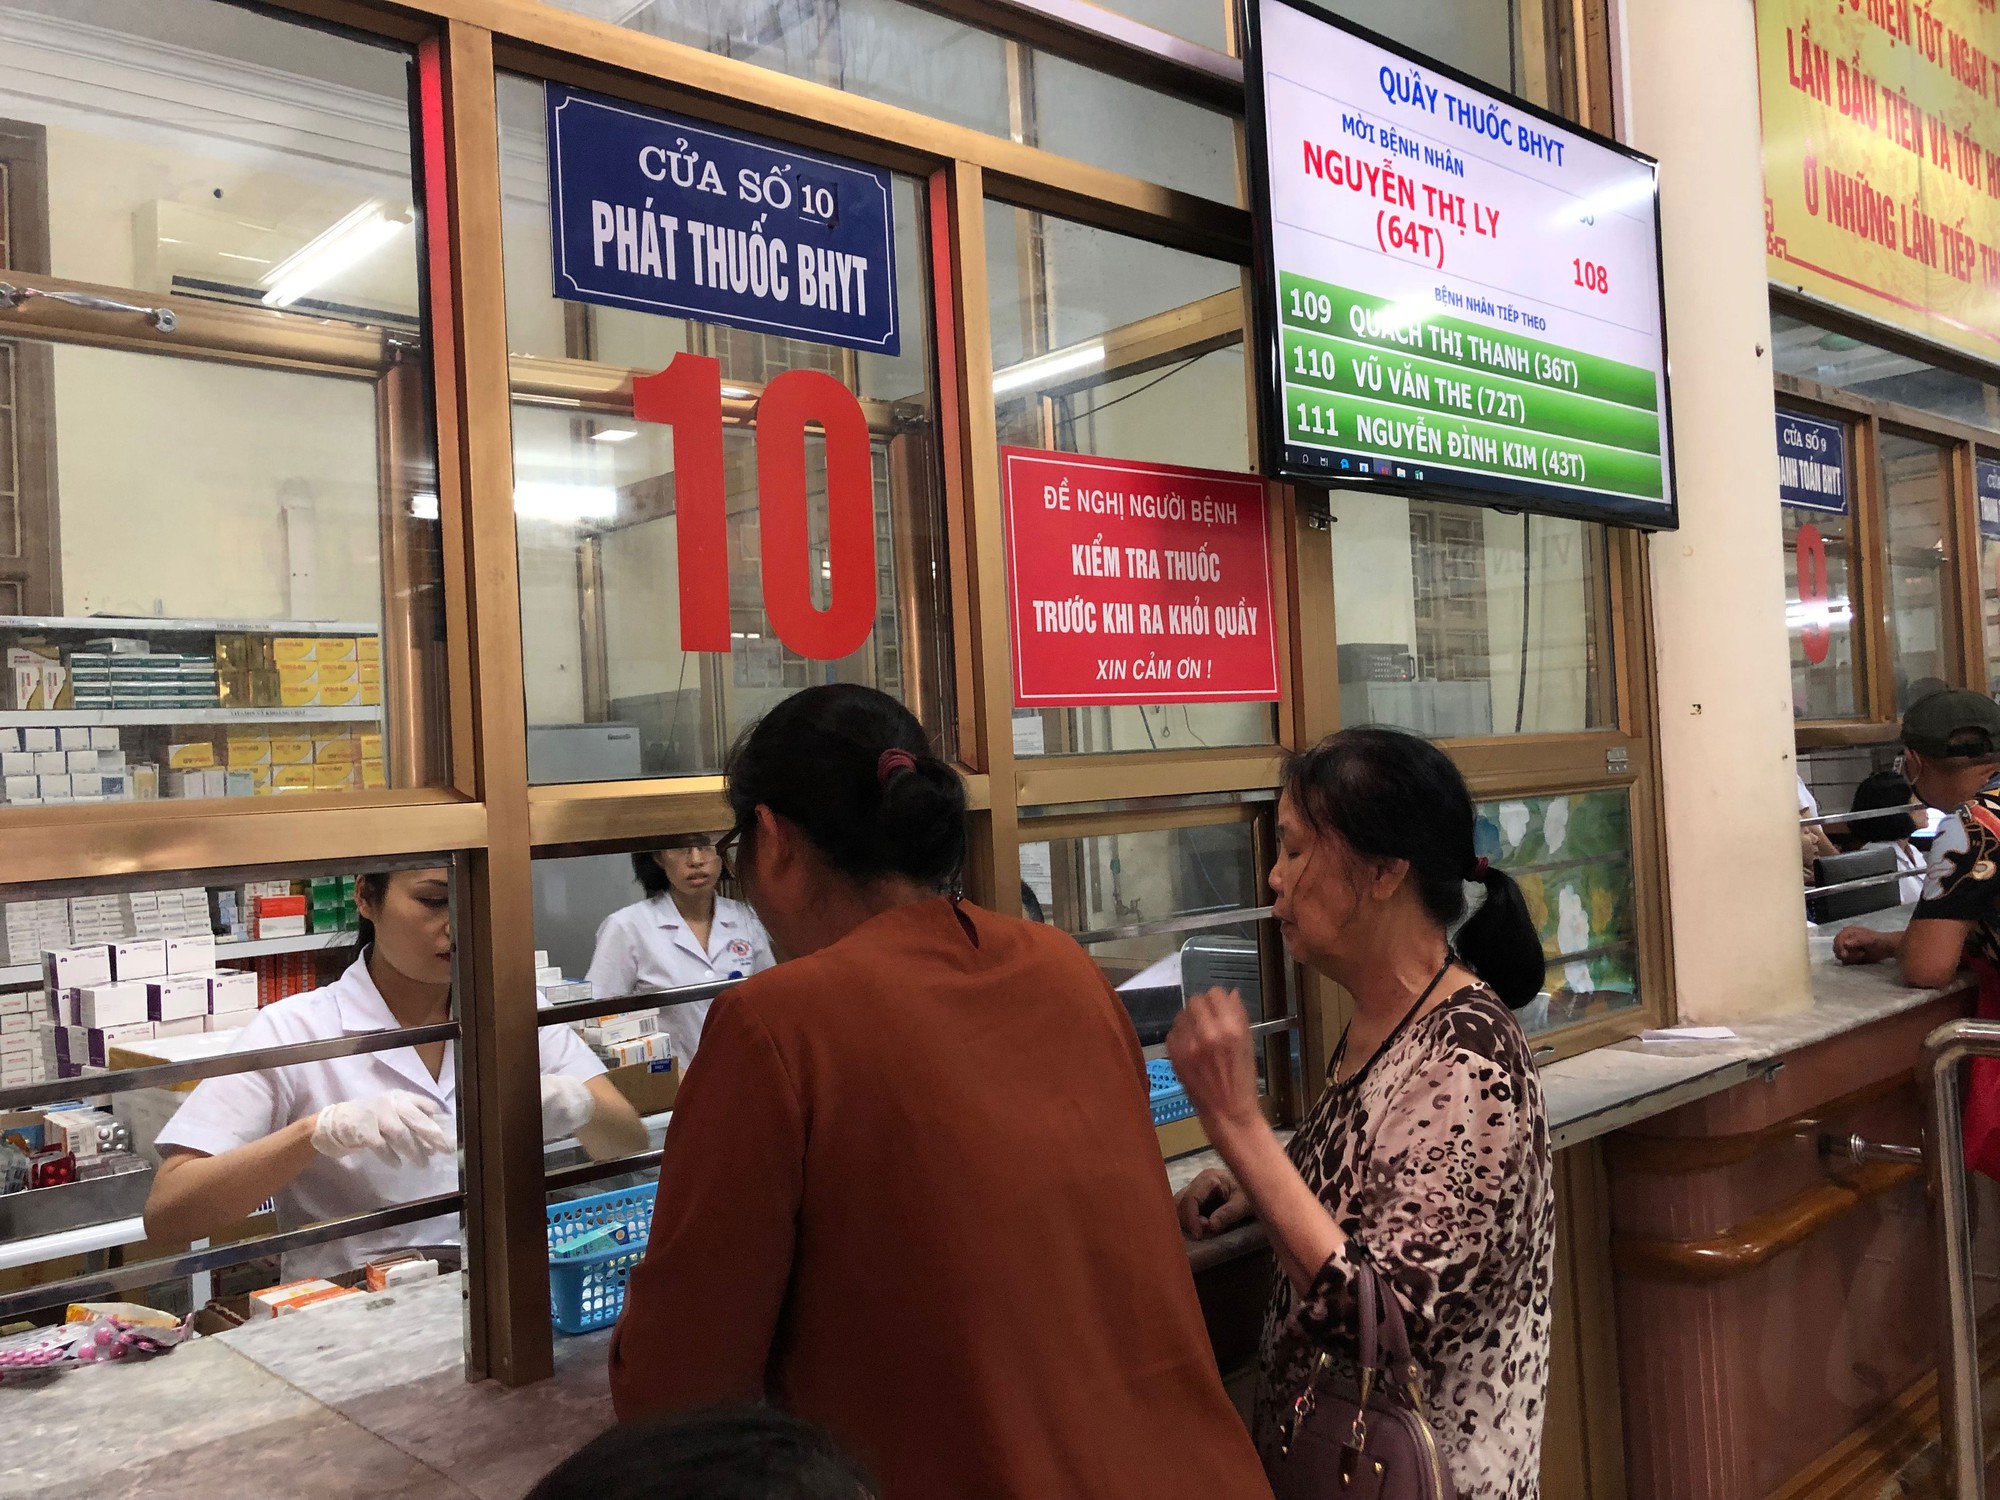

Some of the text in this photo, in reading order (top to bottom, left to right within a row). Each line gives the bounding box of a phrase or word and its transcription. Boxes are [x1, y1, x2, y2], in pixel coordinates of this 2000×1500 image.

[1948, 29, 1988, 99] NGAY
[1379, 66, 1565, 167] QUẦY THUỐC BHYT
[1786, 18, 1831, 106] LẦN
[1836, 50, 1878, 131] ĐẦU
[1881, 85, 1924, 158] TIÊN
[1927, 108, 1951, 174] VÀ
[1953, 122, 1982, 190] TỐT
[638, 137, 834, 219] CỬA SỐ 10
[1342, 112, 1464, 178] MỜI BỆNH NHÂN
[1303, 140, 1500, 239] NGUYỄN THỊ LY
[592, 196, 868, 317] PHÁT THUỐC BHYT
[1376, 210, 1444, 269] (64T)
[1824, 166, 1897, 251] NHỮNG
[1901, 192, 1937, 269] LẦN
[1940, 217, 1975, 284] TIẾP
[1434, 285, 1546, 331] BỆNH NHÂN TIẾP THEO
[1573, 258, 1609, 294] 108
[1290, 288, 1332, 324] 109
[1427, 324, 1463, 361] THỊ
[1467, 334, 1530, 374] THANH
[1535, 351, 1578, 389] (36T)
[1293, 345, 1525, 423] 110 VŨ VĂN THE (72T)
[1297, 402, 1585, 482] 111 NGUYỄN ĐÌNH KIM (43T)
[1783, 423, 1827, 452] CỬA SỐ 9
[632, 351, 877, 661] 10
[1043, 477, 1237, 527] ĐỀ NGHỊ NGƯỜI BỆNH
[1799, 455, 1822, 493] TOÁN
[1072, 532, 1220, 583] KIỂM TRA THUỐC
[1032, 594, 1258, 638] TRƯỚC KHI RA KHỎI QUẦY
[1096, 659, 1127, 680] XIN
[1132, 651, 1171, 680] CẢM
[1177, 656, 1201, 680] ƠN
